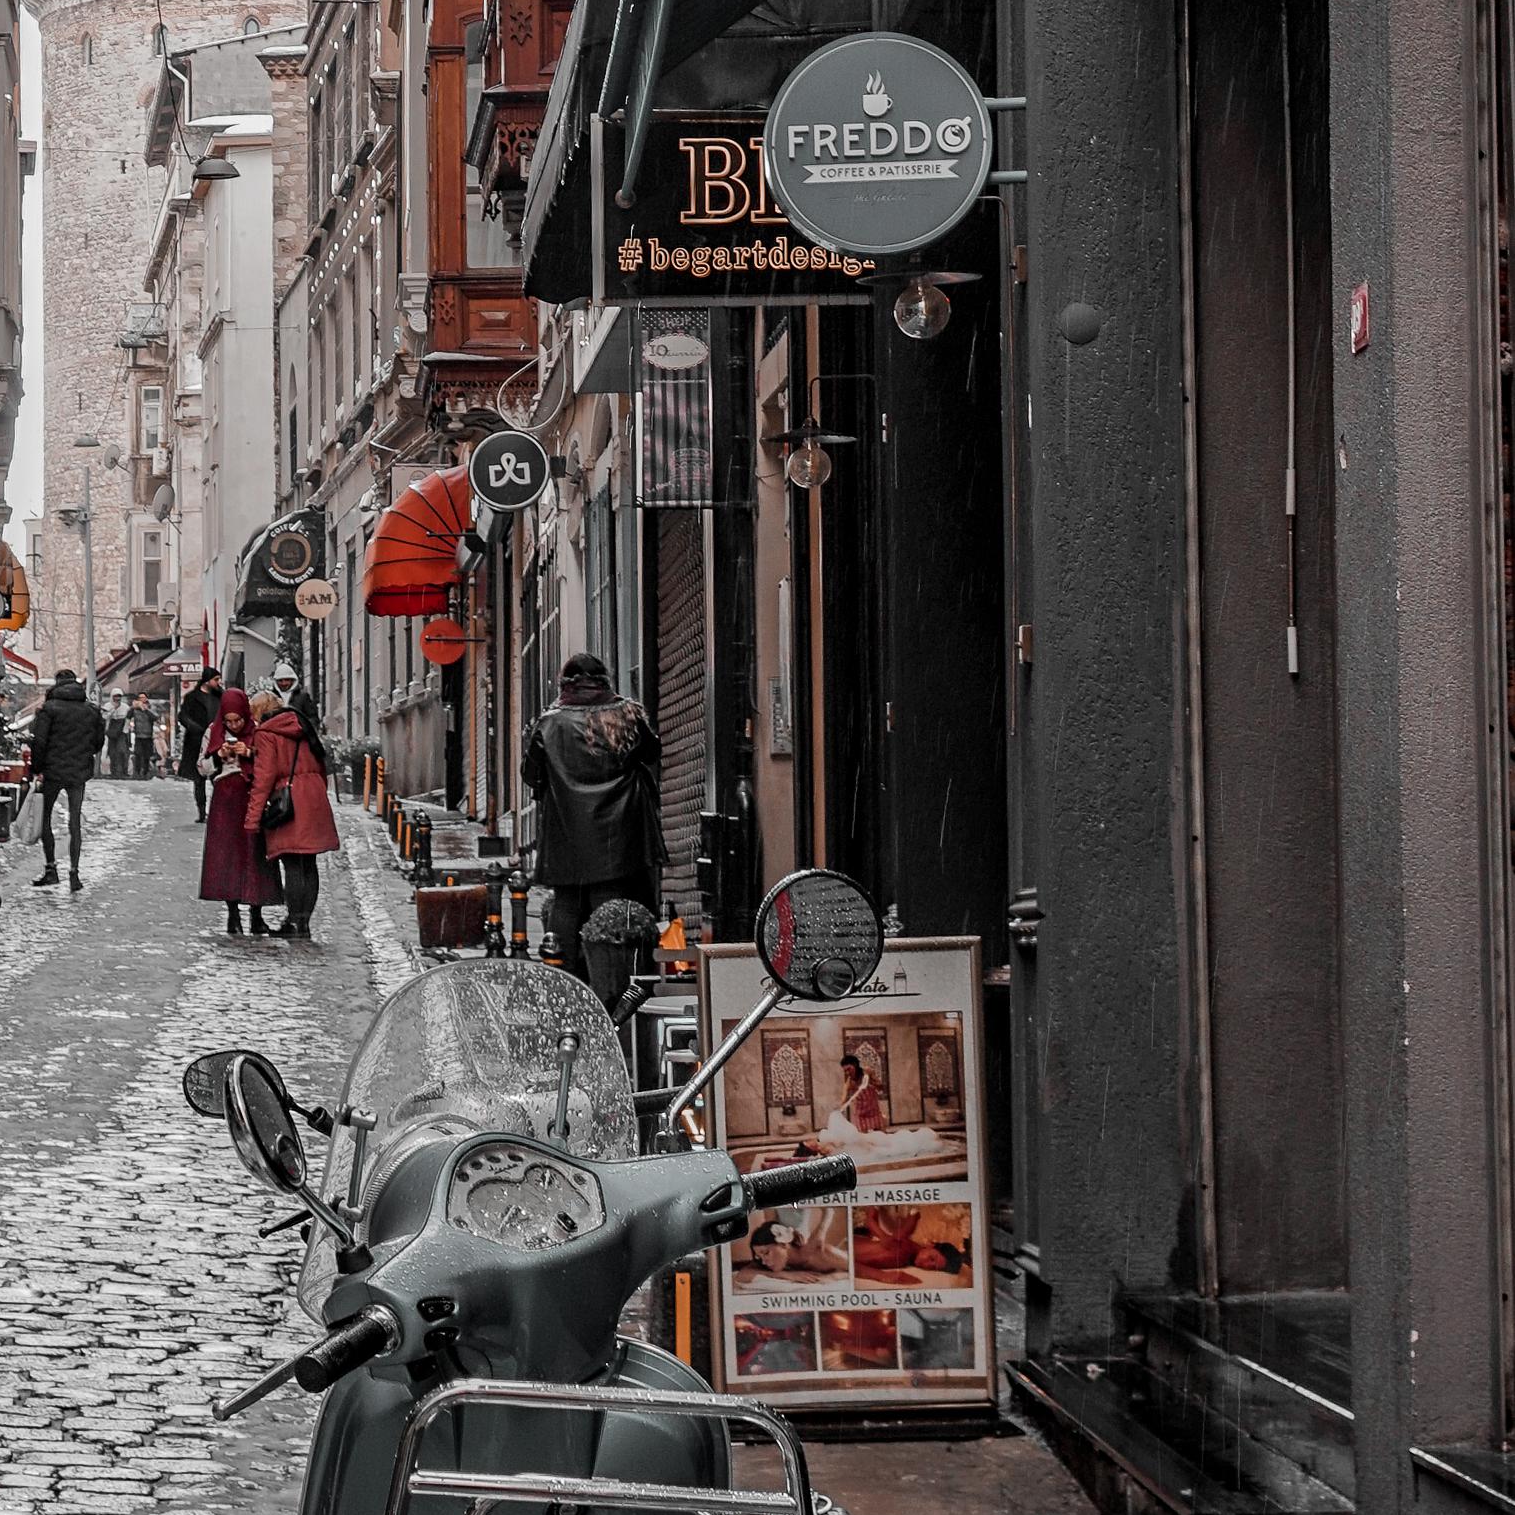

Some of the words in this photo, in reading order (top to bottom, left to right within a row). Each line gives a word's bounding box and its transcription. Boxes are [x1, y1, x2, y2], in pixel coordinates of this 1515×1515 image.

[787, 116, 972, 160] FREDDO
[820, 167, 865, 179] COFFEE
[868, 167, 876, 177] &
[879, 164, 942, 177] PATISSERIE
[822, 1190, 859, 1204] BATH
[874, 1188, 941, 1203] MASSAGE
[761, 1294, 835, 1309] SWIMMING
[841, 1293, 878, 1307] POOL
[896, 1292, 943, 1305] SAUNA
